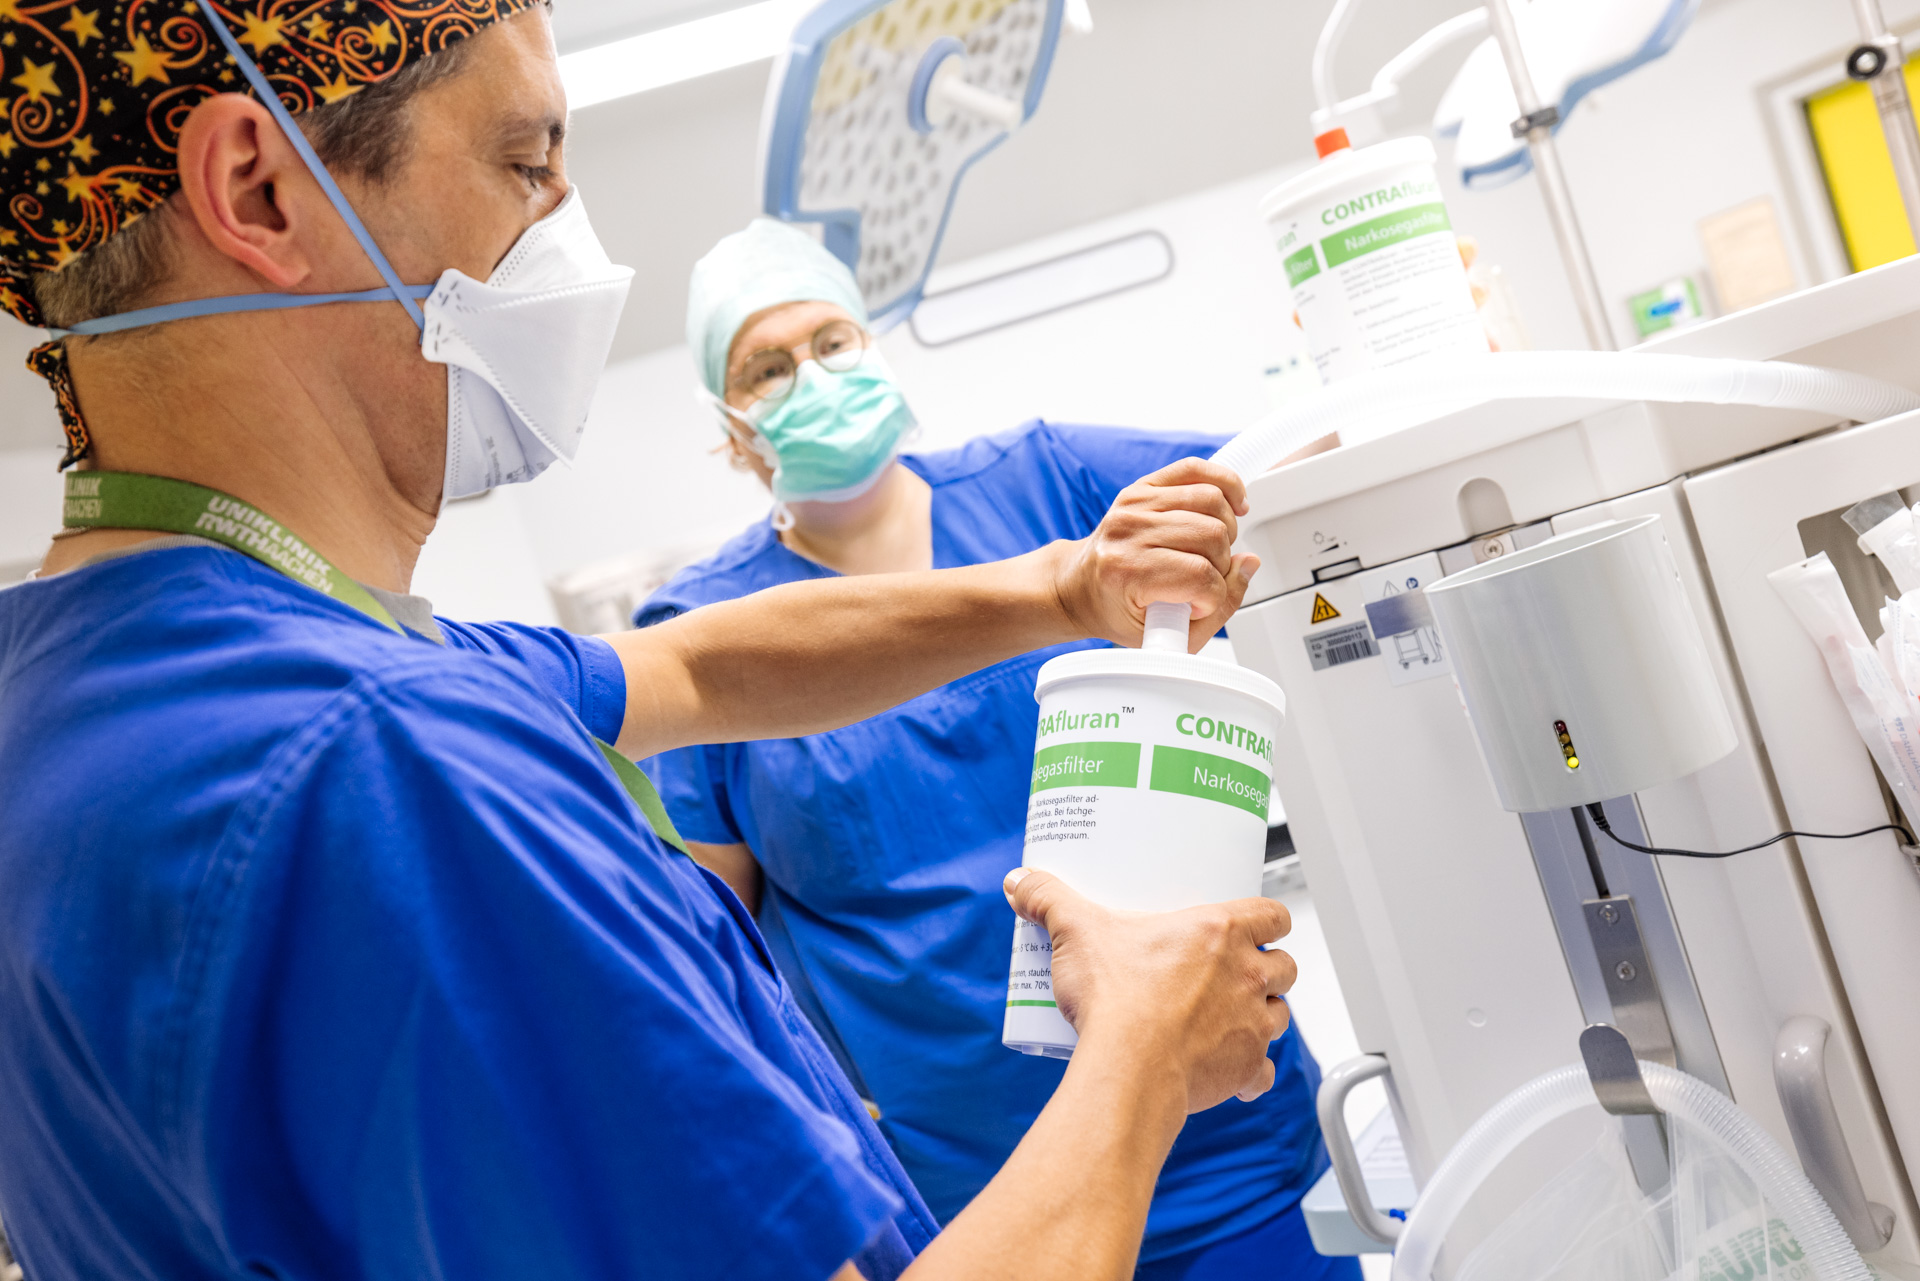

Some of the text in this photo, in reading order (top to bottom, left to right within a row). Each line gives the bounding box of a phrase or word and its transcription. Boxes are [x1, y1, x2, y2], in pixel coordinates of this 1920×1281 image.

[207, 496, 331, 576] UNIKLINIK
[1085, 794, 1100, 803] ad-
[1054, 807, 1065, 817] Bei
[1066, 806, 1096, 817] fachge-
[1046, 820, 1058, 829] den
[1059, 819, 1097, 828] Patienten
[1030, 943, 1039, 952] bis
[1034, 980, 1050, 991] 70%
